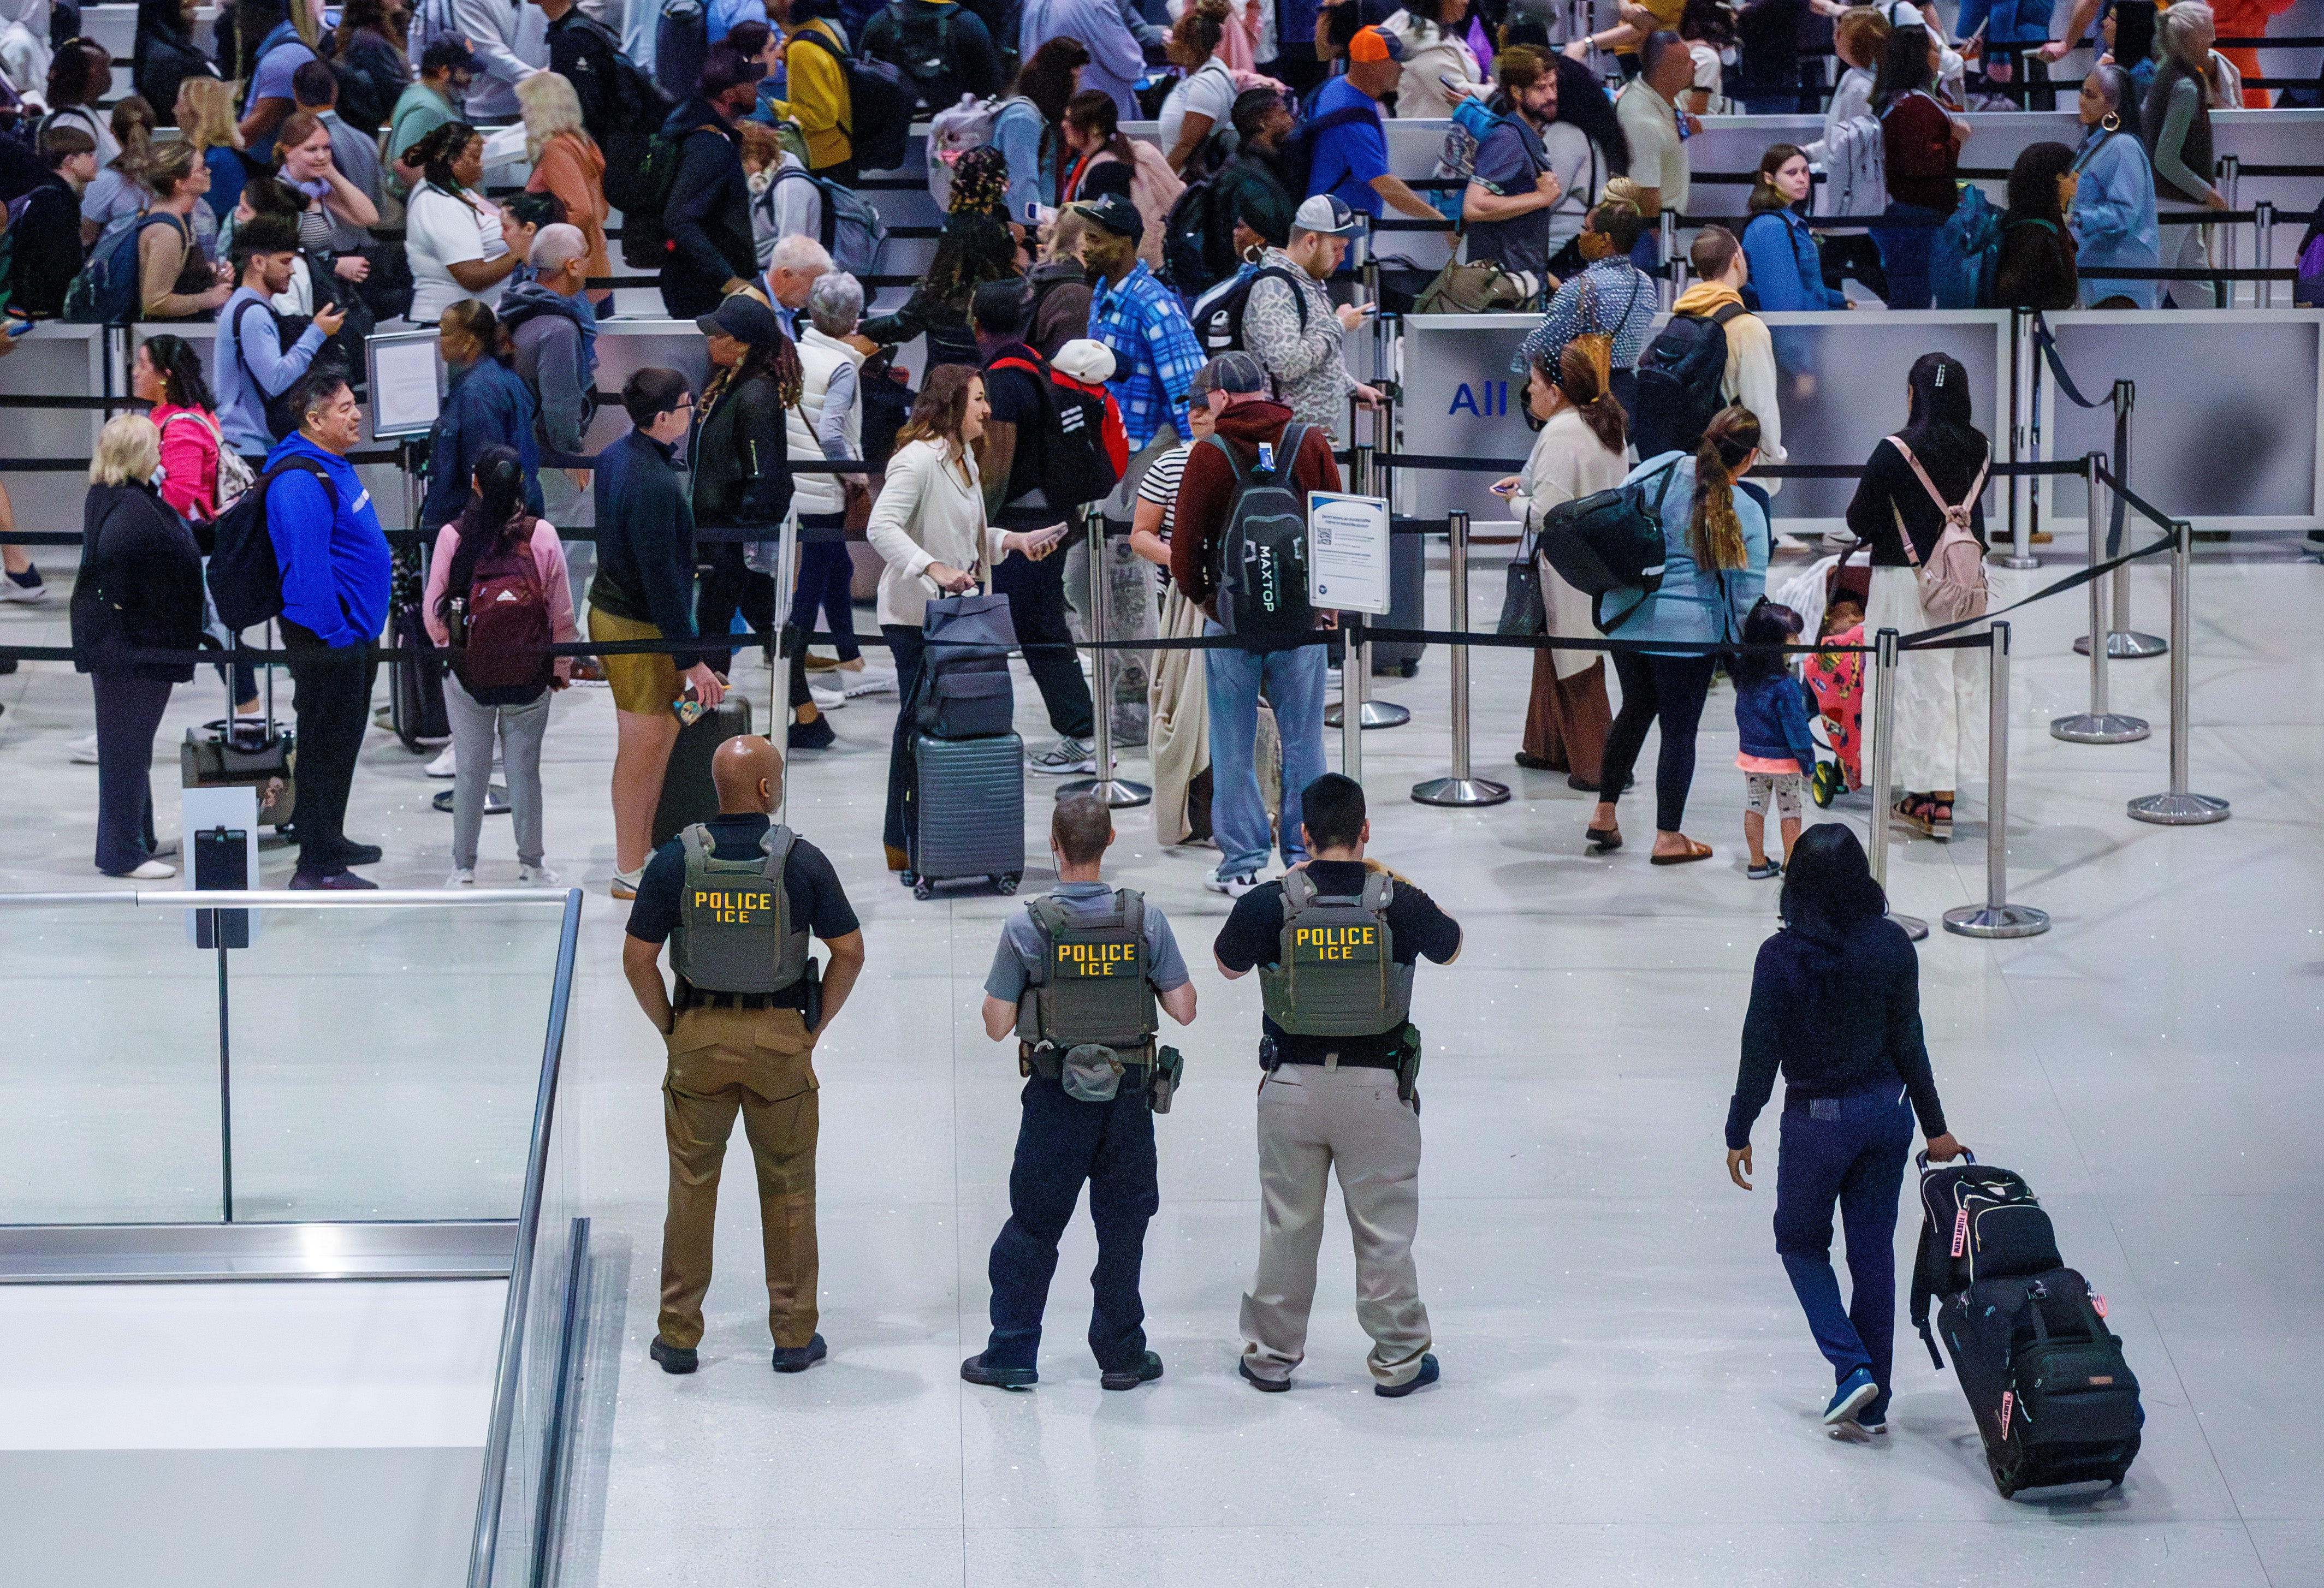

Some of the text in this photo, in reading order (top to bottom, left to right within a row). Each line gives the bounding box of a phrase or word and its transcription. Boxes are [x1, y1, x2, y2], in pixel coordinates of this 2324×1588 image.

[1449, 380, 1507, 417] All
[1260, 546, 1274, 611] MAXTOP
[695, 892, 771, 909] POLICE
[716, 910, 750, 923] ICE
[1297, 927, 1374, 945] POLICE
[1058, 944, 1135, 962] POLICE
[1319, 946, 1353, 960] ICE
[1080, 962, 1113, 976] ICE
[1957, 1217, 1965, 1236] FLIGHT
